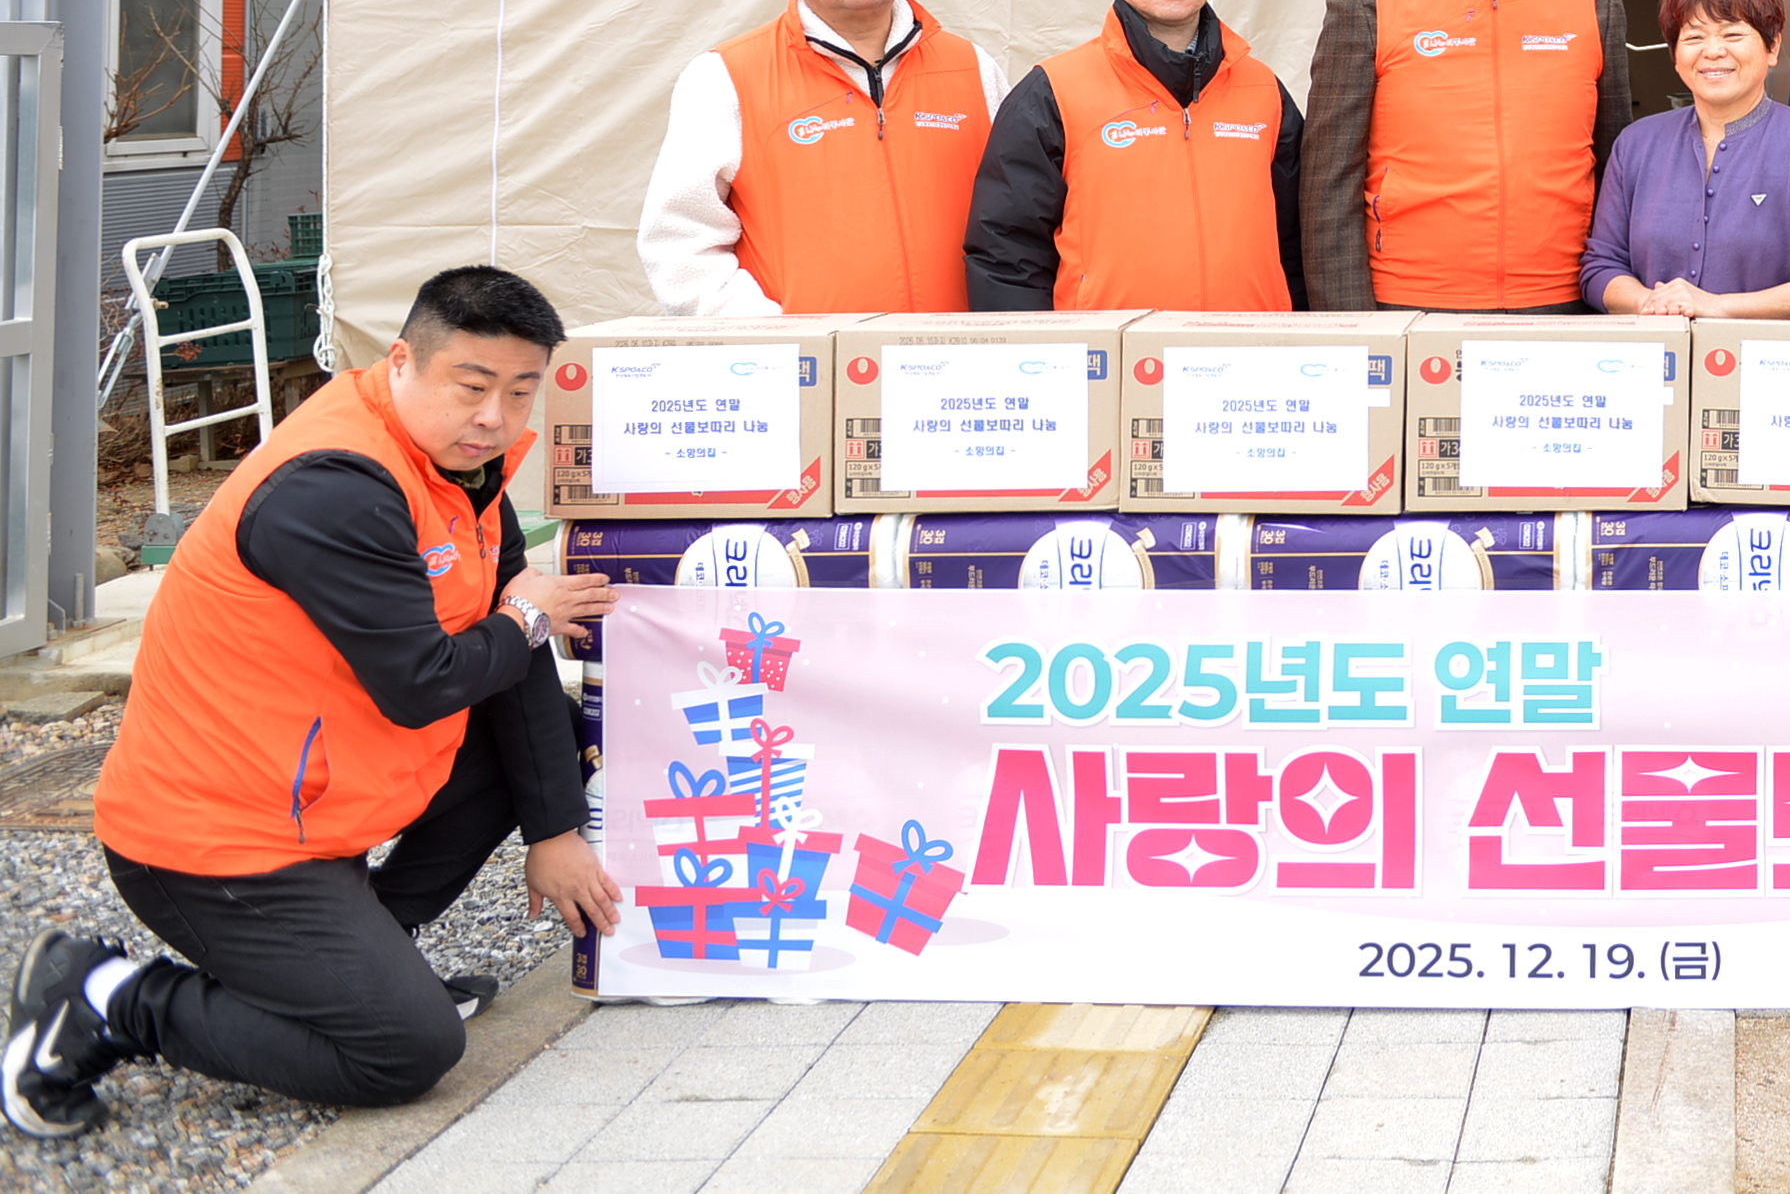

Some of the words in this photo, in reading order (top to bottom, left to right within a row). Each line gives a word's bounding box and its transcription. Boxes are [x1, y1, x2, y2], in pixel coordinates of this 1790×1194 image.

[651, 399, 708, 413] 2025년도
[715, 398, 741, 412] 연말
[940, 397, 997, 411] 2025년도
[1004, 396, 1030, 411] 연말
[1222, 399, 1278, 413] 2025년도
[1285, 399, 1310, 413] 연말
[1519, 394, 1575, 408] 2025년도
[1581, 394, 1607, 409] 연말
[623, 421, 662, 436] 사랑의
[670, 420, 736, 435] 선물보따리
[743, 419, 769, 433] 나눔
[913, 419, 951, 433] 사랑의
[960, 418, 1024, 433] 선물보따리
[1031, 418, 1057, 432] 나눔
[1195, 421, 1233, 435] 사랑의
[1241, 421, 1305, 434] 선물보따리
[1312, 421, 1337, 434] 나눔
[1492, 415, 1530, 429] 사랑의
[1538, 416, 1601, 430] 선물보따리
[1608, 417, 1633, 430] 나눔
[676, 447, 716, 459] 소망의집
[965, 445, 1005, 457] 소망의집
[1247, 447, 1286, 458] 소망의집
[1543, 442, 1582, 454] 소망의집
[1604, 521, 1614, 536] 30
[581, 531, 592, 547] 30
[923, 530, 933, 544] 30
[1264, 529, 1273, 544] 30
[985, 639, 1408, 724] 2025년도
[1434, 640, 1602, 724] 연말
[970, 749, 1416, 889] 사랑의
[1358, 942, 1485, 978] 2025.
[1502, 943, 1565, 979] 12.
[1582, 943, 1646, 979] 19.
[1660, 941, 1721, 981] (금)
[576, 964, 587, 975] 30
